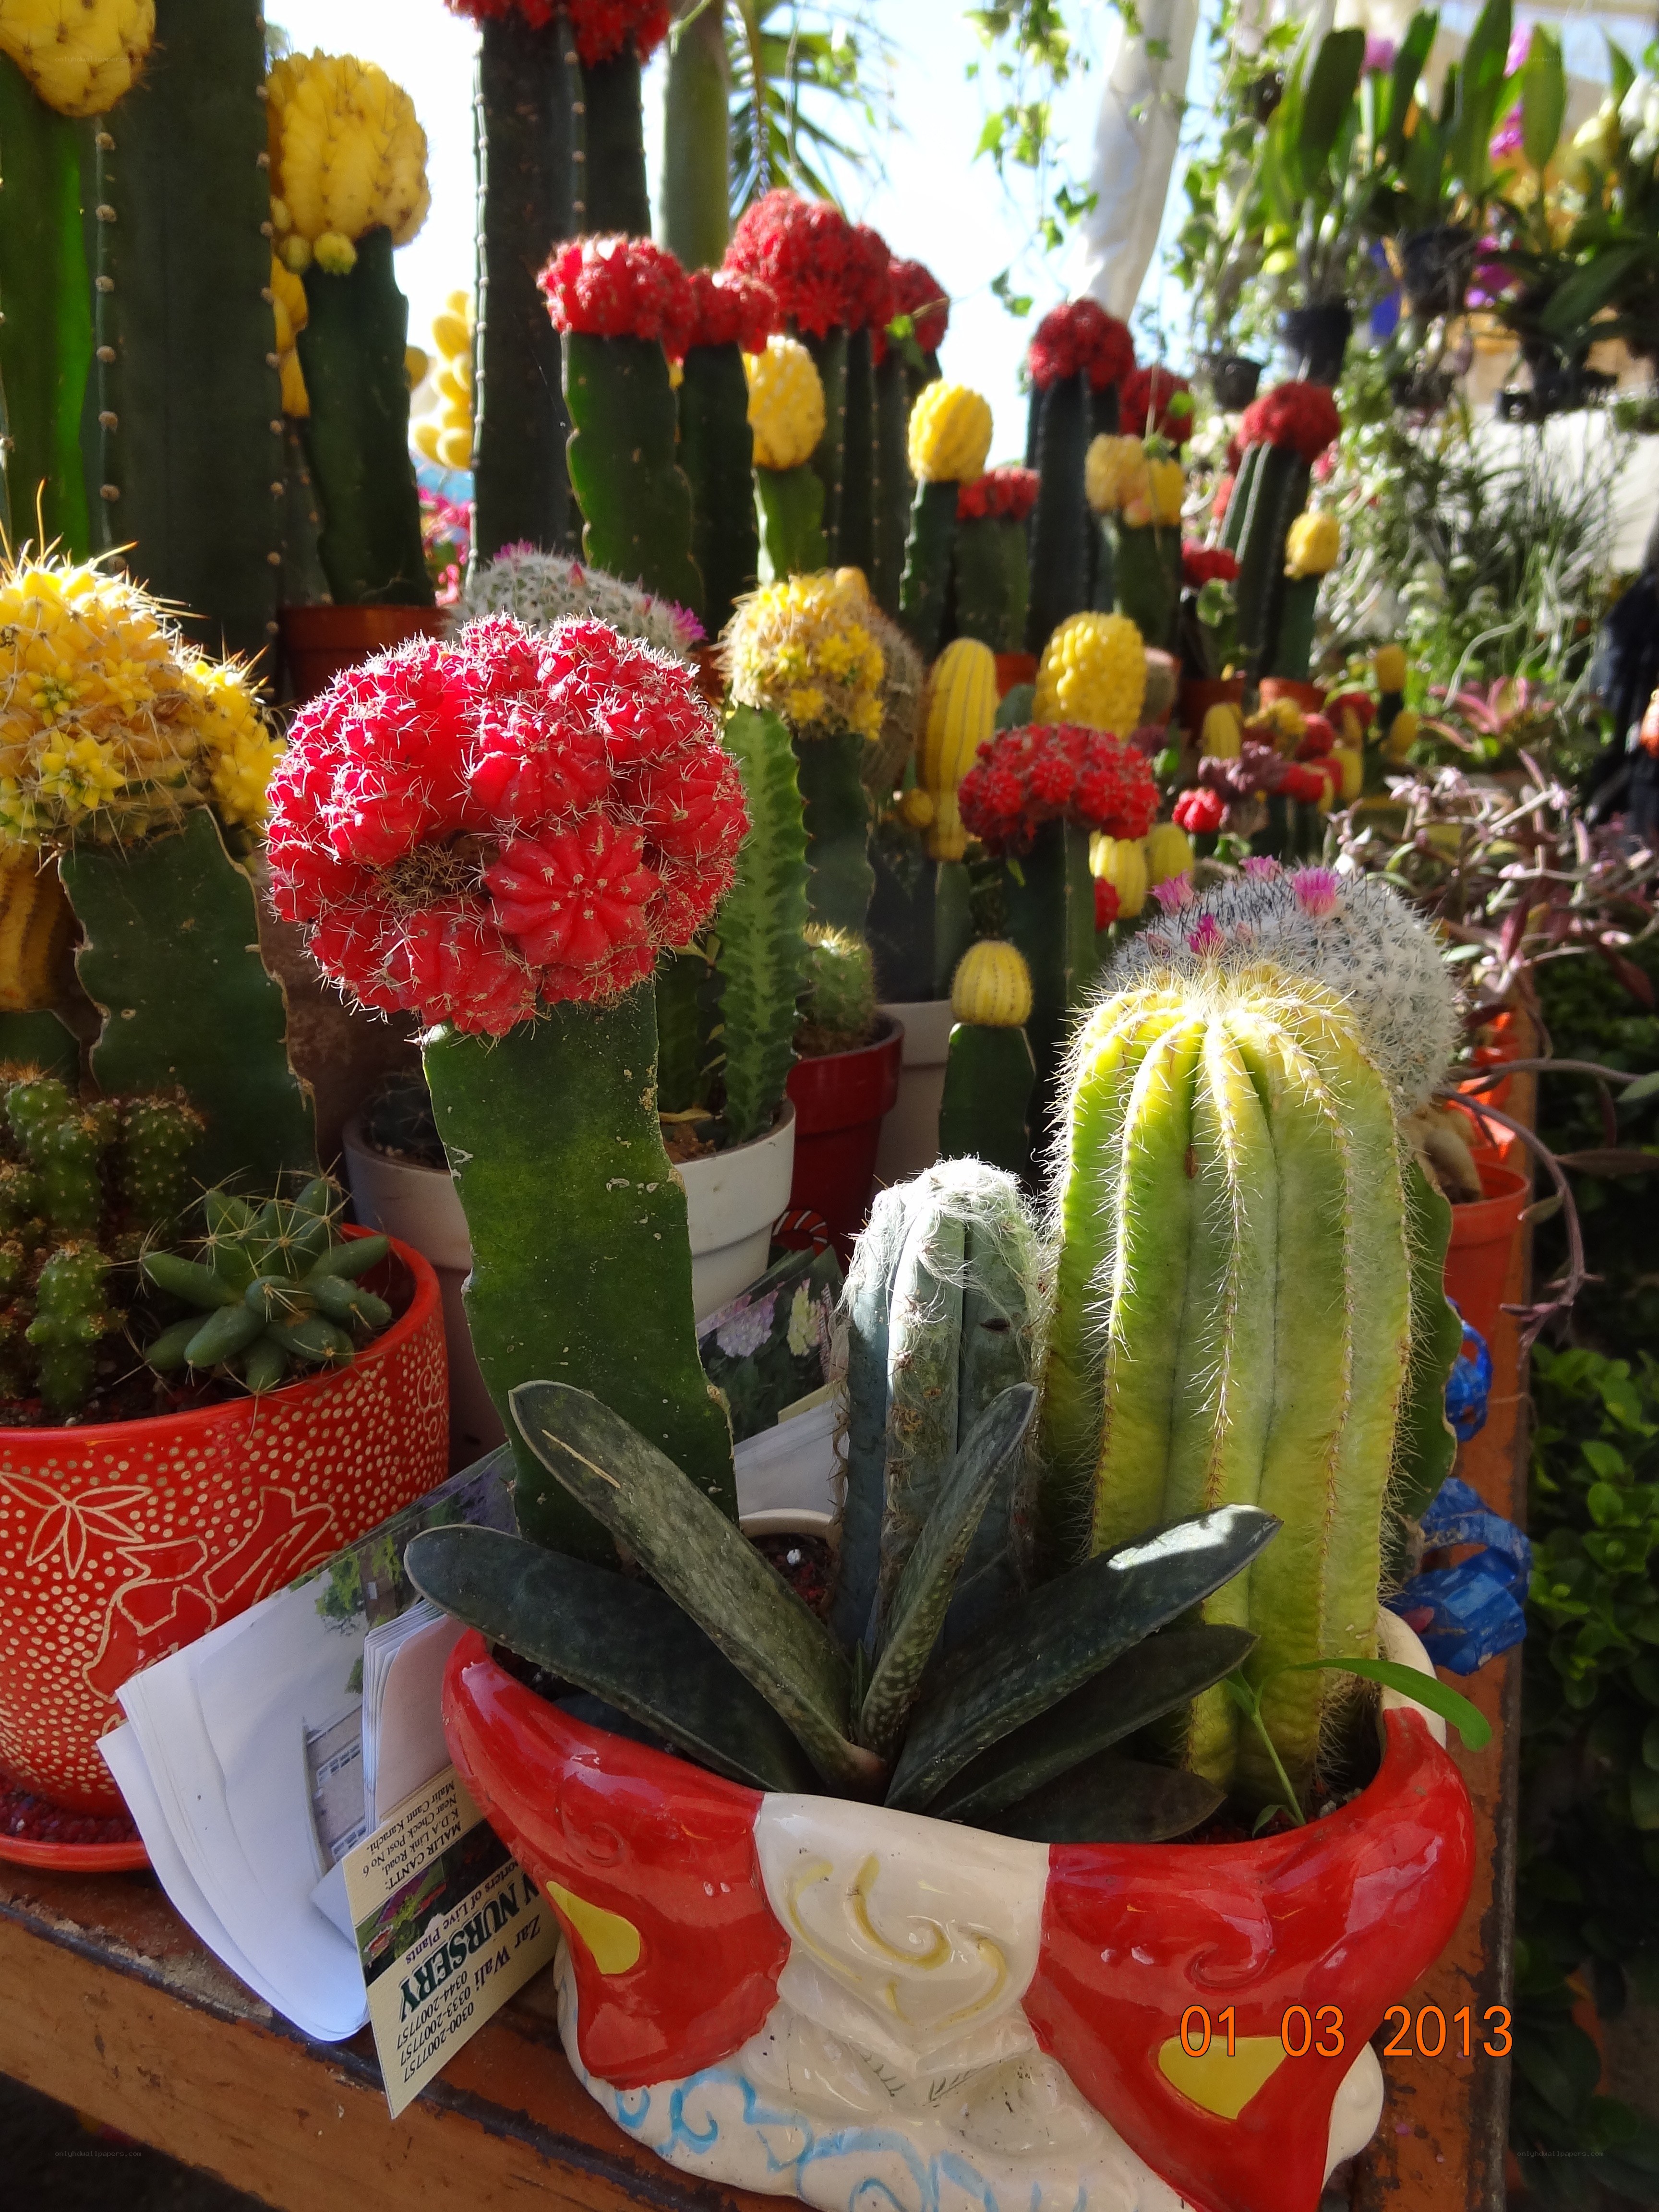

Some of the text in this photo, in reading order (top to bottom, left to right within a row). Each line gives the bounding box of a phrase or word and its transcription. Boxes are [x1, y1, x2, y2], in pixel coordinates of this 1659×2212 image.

[363, 1793, 457, 1877] Near Check Post No 6
[367, 1780, 455, 1855] Malir Cantt Karachi.
[382, 1807, 459, 1875] K.D.A Link Road,
[385, 1821, 461, 1890] MALIR CANTT:
[443, 1903, 468, 1930] Live
[470, 1890, 482, 1910] of
[400, 1882, 520, 2022] NURSERY
[406, 1927, 441, 1964] Plants
[474, 1913, 541, 1991] Zar Wali
[397, 1970, 468, 2050] 0344-2007757
[400, 1986, 471, 2067] 0333-2007757
[404, 2001, 474, 2083] 0300-2007757
